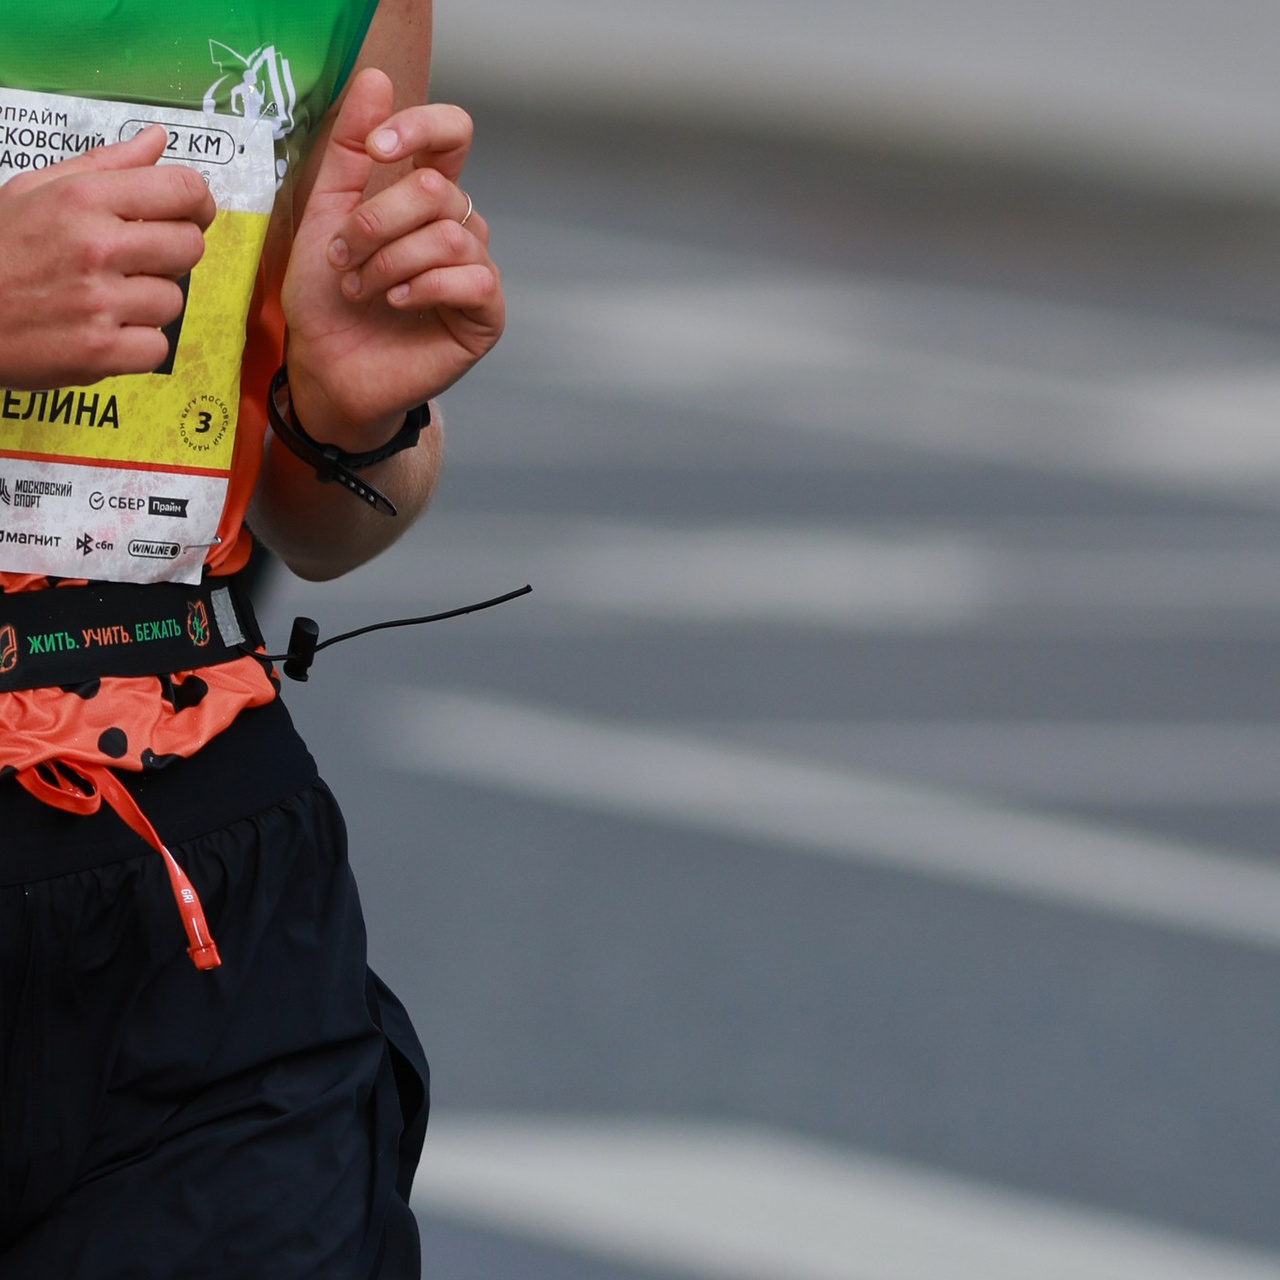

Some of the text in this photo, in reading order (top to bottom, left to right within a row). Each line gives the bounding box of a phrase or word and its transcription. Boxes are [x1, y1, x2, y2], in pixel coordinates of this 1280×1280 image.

[195, 411, 212, 433] 3
[15, 478, 73, 497] МОСКОВСКИЙ
[13, 493, 41, 509] СПОРТ
[108, 495, 182, 514] СБЕР Прайм
[131, 543, 171, 556] WINLINE
[27, 618, 181, 654] ЖИТЬ. УЧИТЬ. БЕЖАТЬ
